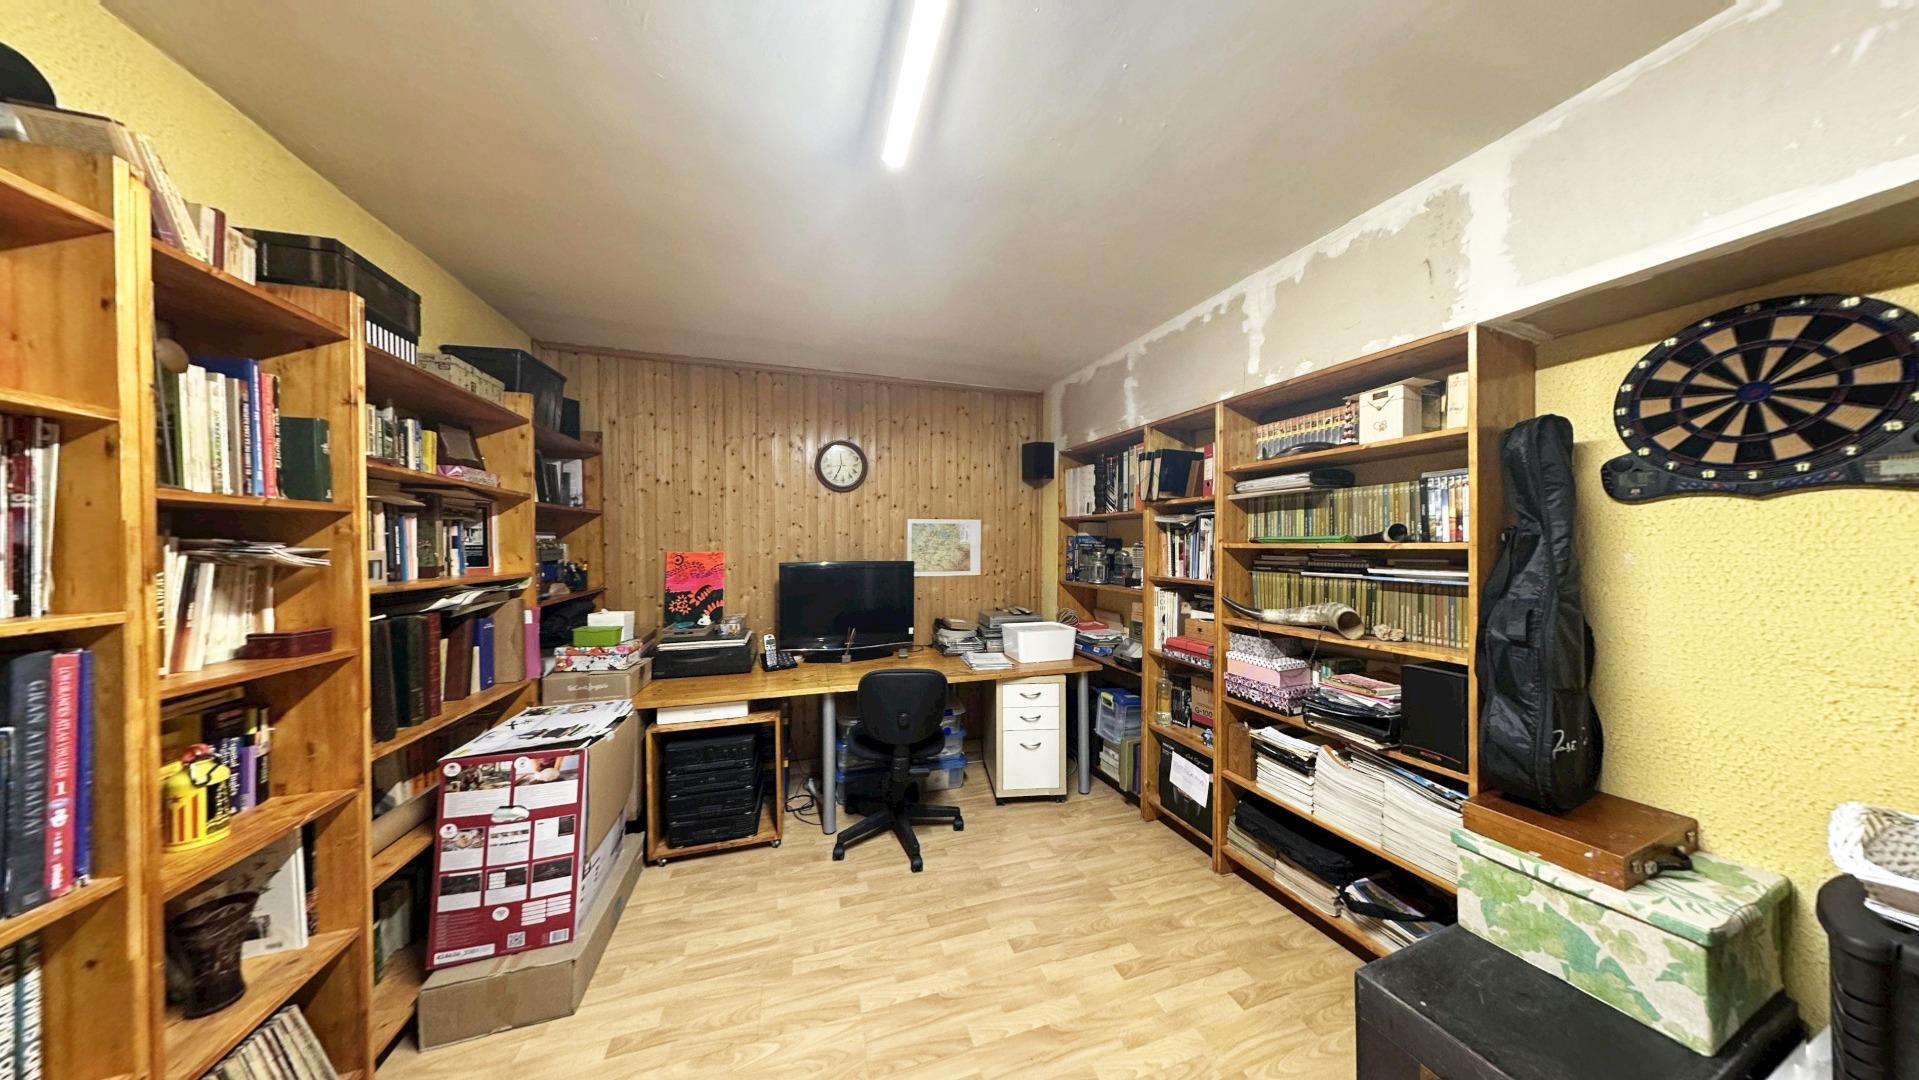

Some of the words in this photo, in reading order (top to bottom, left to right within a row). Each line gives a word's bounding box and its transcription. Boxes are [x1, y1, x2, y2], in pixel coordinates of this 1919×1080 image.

[1846, 446, 1857, 456] 2
[1748, 471, 1758, 480] 3
[1795, 462, 1812, 472] 17
[26, 680, 47, 724] GRAN
[24, 730, 46, 778] ATLAS
[22, 782, 44, 837] SALVAT
